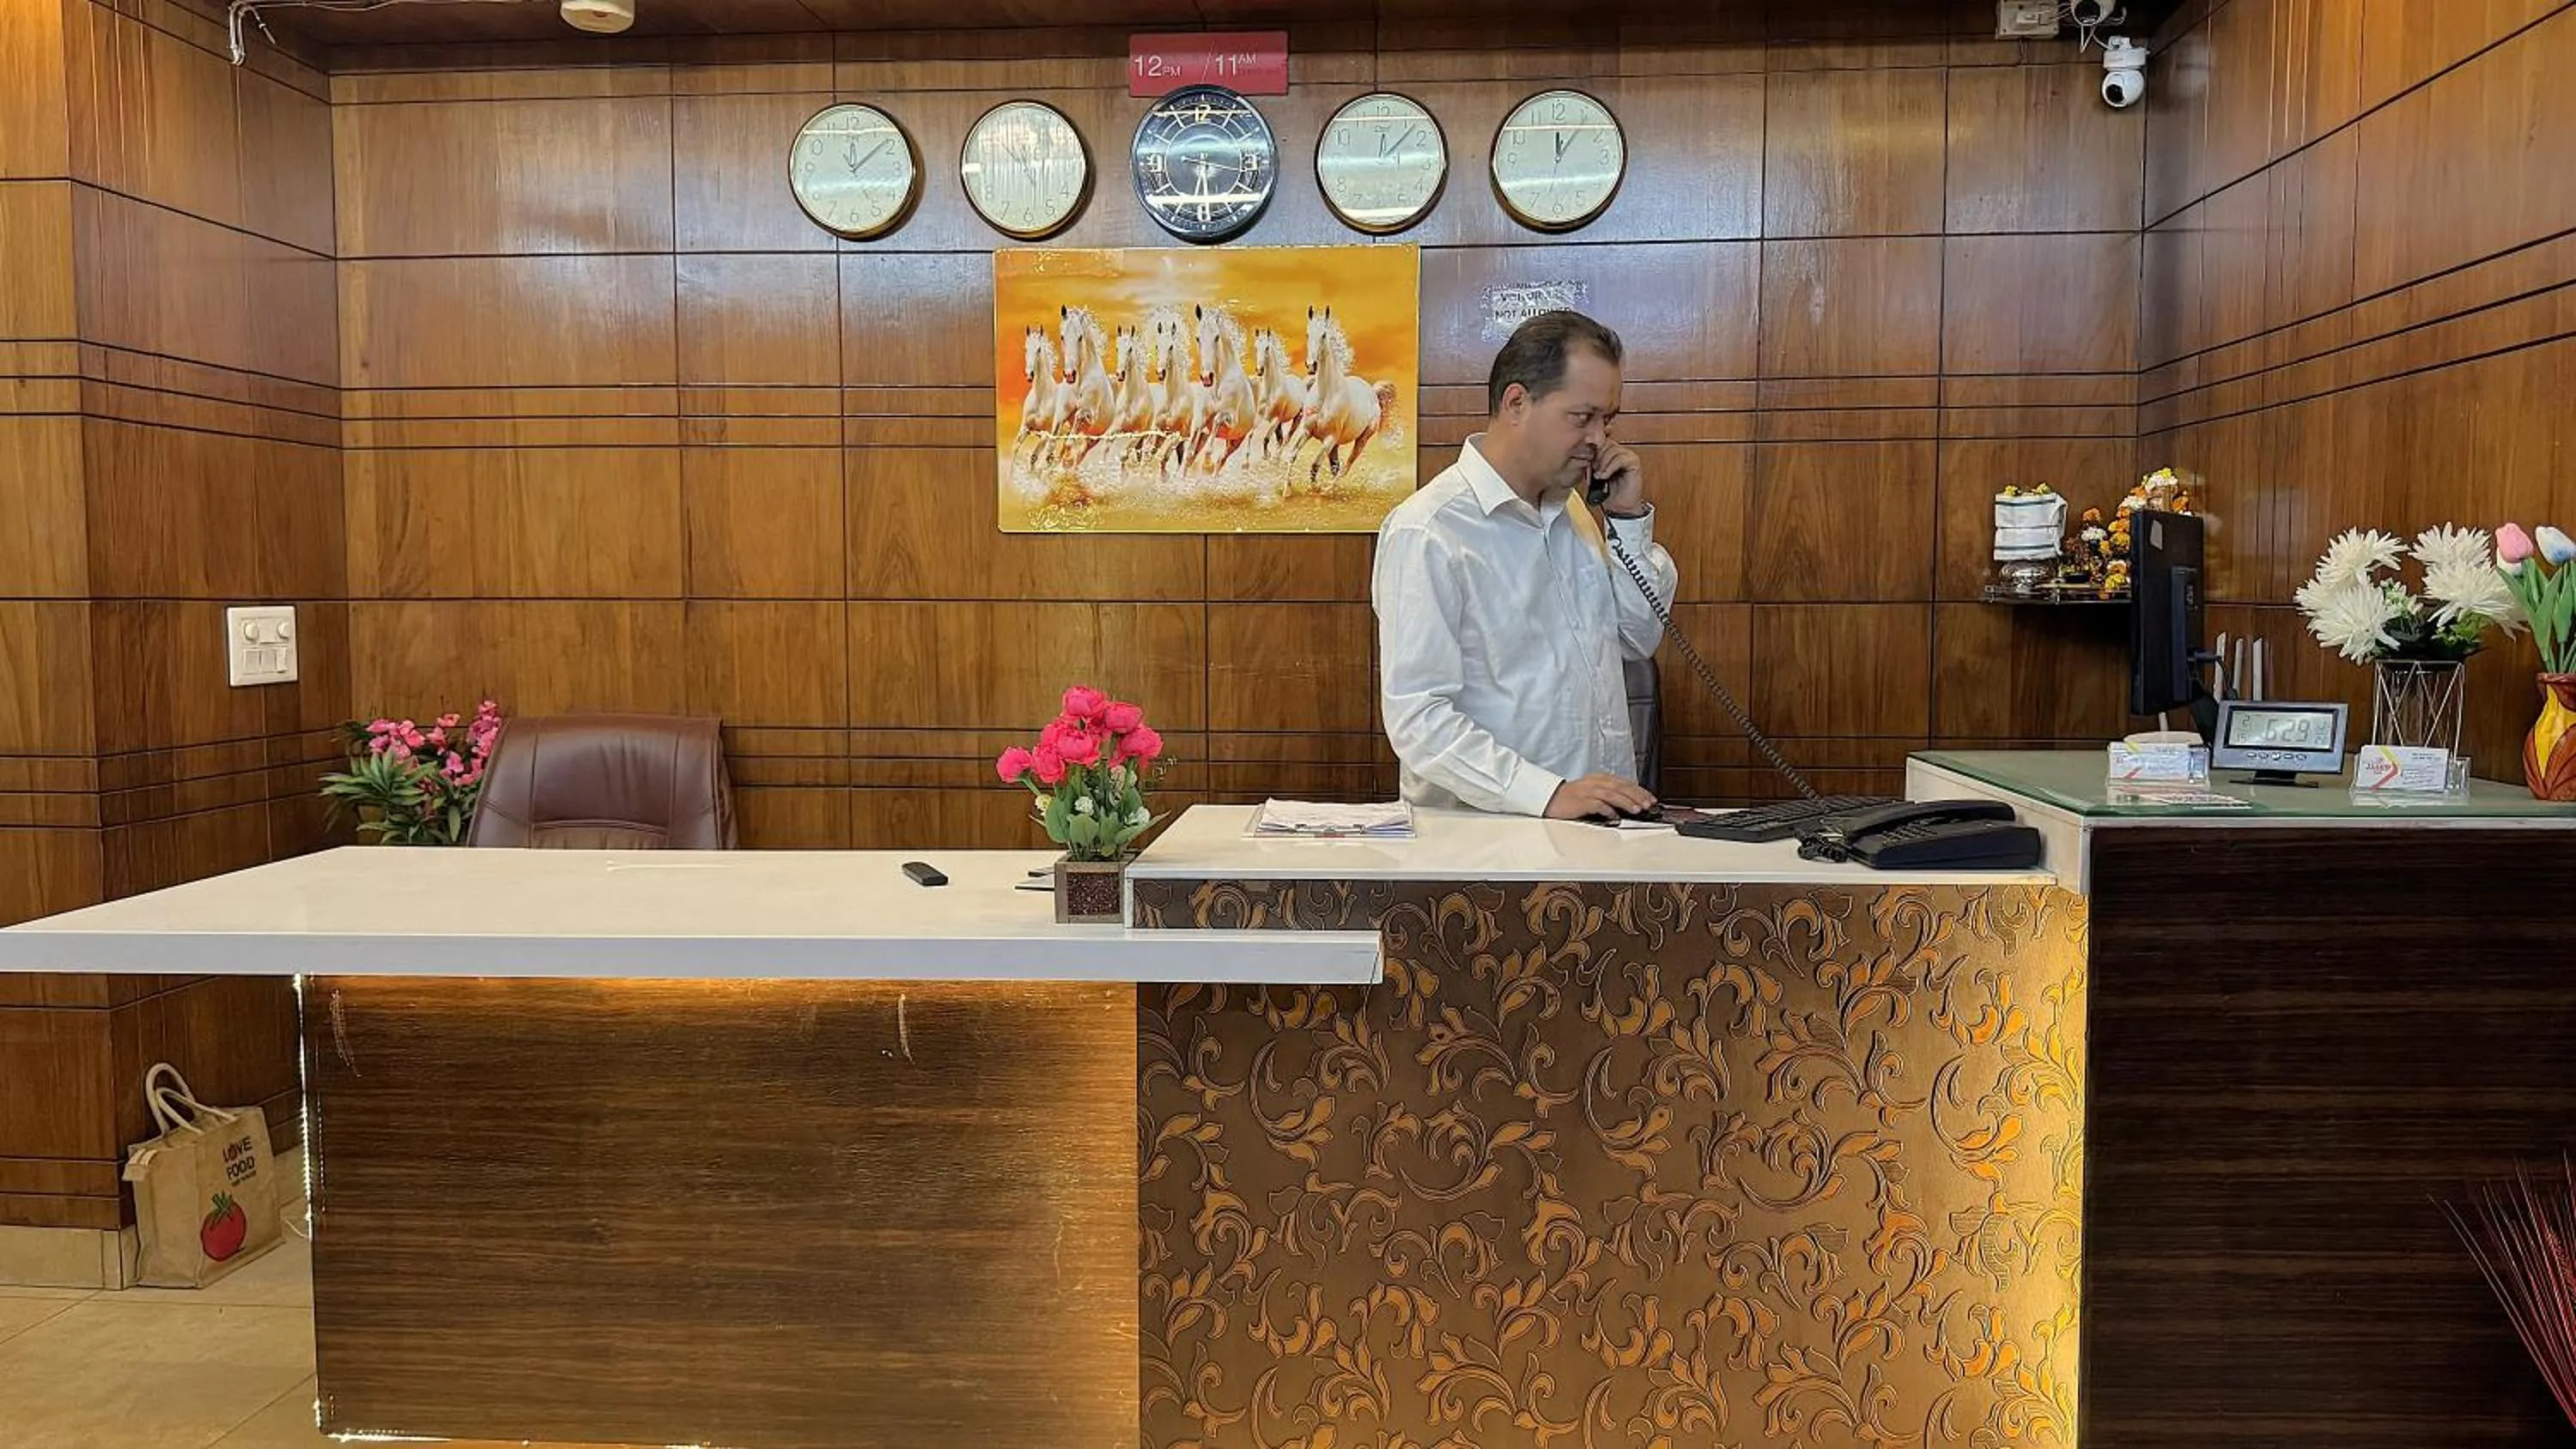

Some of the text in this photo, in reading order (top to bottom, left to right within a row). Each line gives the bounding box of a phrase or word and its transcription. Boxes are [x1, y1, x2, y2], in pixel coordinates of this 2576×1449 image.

[1194, 104, 1212, 124] 12
[1552, 102, 1565, 121] 12
[222, 1135, 253, 1163] LOVE
[226, 1155, 256, 1180] FOOD
